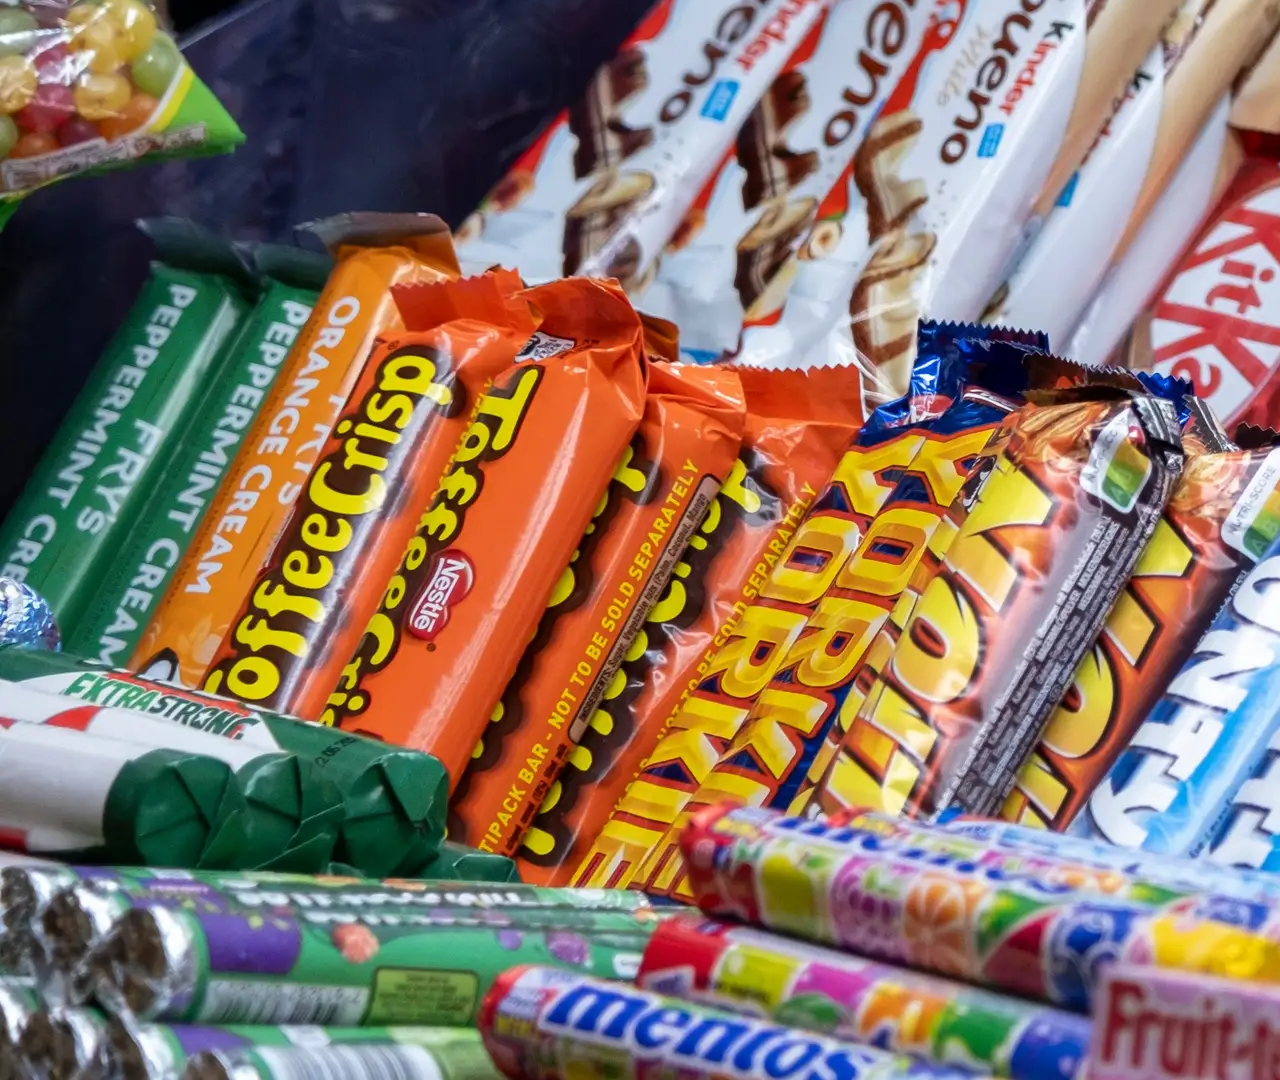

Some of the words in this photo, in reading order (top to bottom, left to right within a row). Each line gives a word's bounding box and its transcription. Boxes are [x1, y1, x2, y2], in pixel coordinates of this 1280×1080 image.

[41, 276, 200, 511] PEPPERMINT
[156, 293, 318, 534] PEPPERMINT
[252, 290, 366, 465] ORANGE
[309, 353, 452, 514] Crisp
[68, 412, 168, 544] FRY'S
[181, 458, 276, 602] CREAM
[382, 364, 541, 611] Toffee
[622, 457, 705, 582] SEPARATELY
[738, 480, 819, 600] SEPARATELY
[85, 531, 184, 672] CREAM
[411, 554, 465, 636] Nestlé
[581, 630, 610, 661] BE
[595, 577, 638, 634] SOLD
[62, 671, 157, 713] EXTRA
[544, 684, 581, 730] NOT
[567, 656, 596, 689] TO
[571, 435, 925, 888] YORKIE
[515, 741, 550, 785] BAR
[545, 976, 880, 1080] mentos
